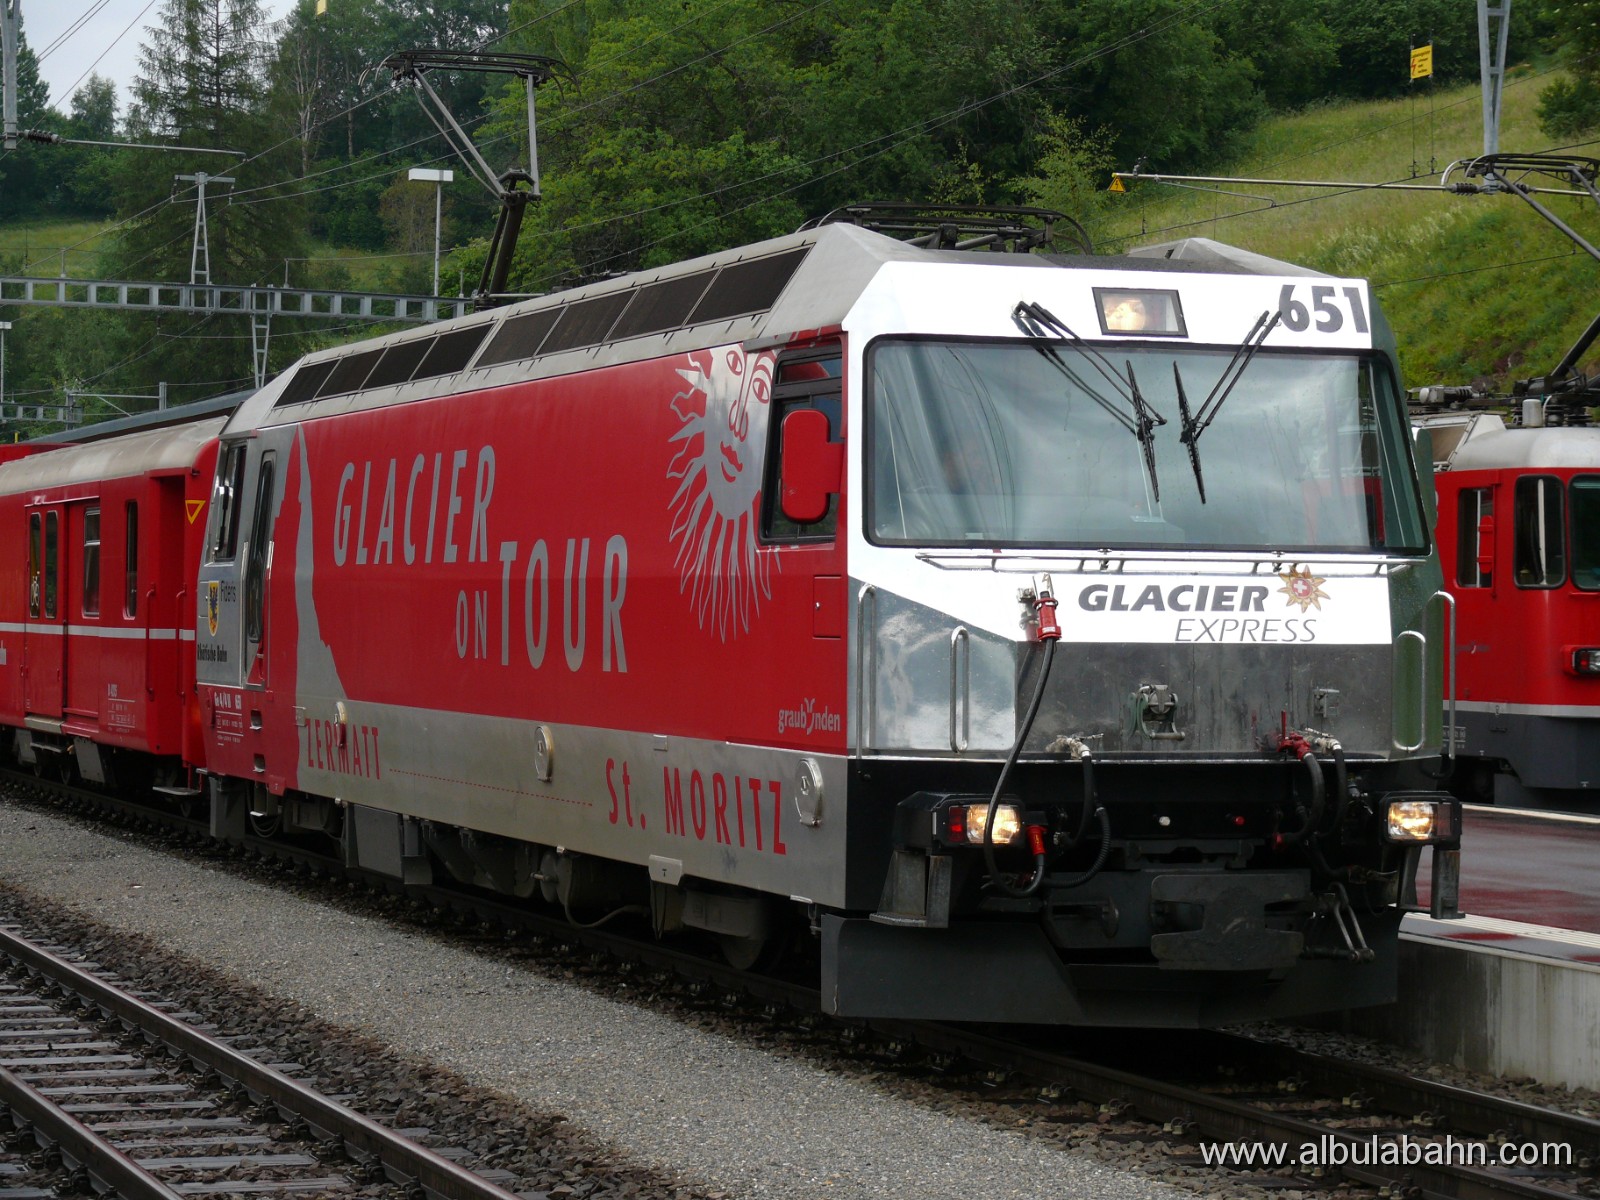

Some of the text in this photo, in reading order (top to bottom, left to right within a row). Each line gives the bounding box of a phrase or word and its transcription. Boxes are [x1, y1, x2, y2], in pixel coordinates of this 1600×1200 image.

[1278, 284, 1369, 333] 651
[333, 445, 496, 567] GLACIER
[455, 590, 488, 660] ON
[499, 534, 628, 673] TOUR
[1078, 584, 1269, 612] GLACIER
[1174, 618, 1317, 642] EXPRESS
[305, 718, 381, 780] ZERMATT
[606, 758, 787, 855] St. MORITZ
